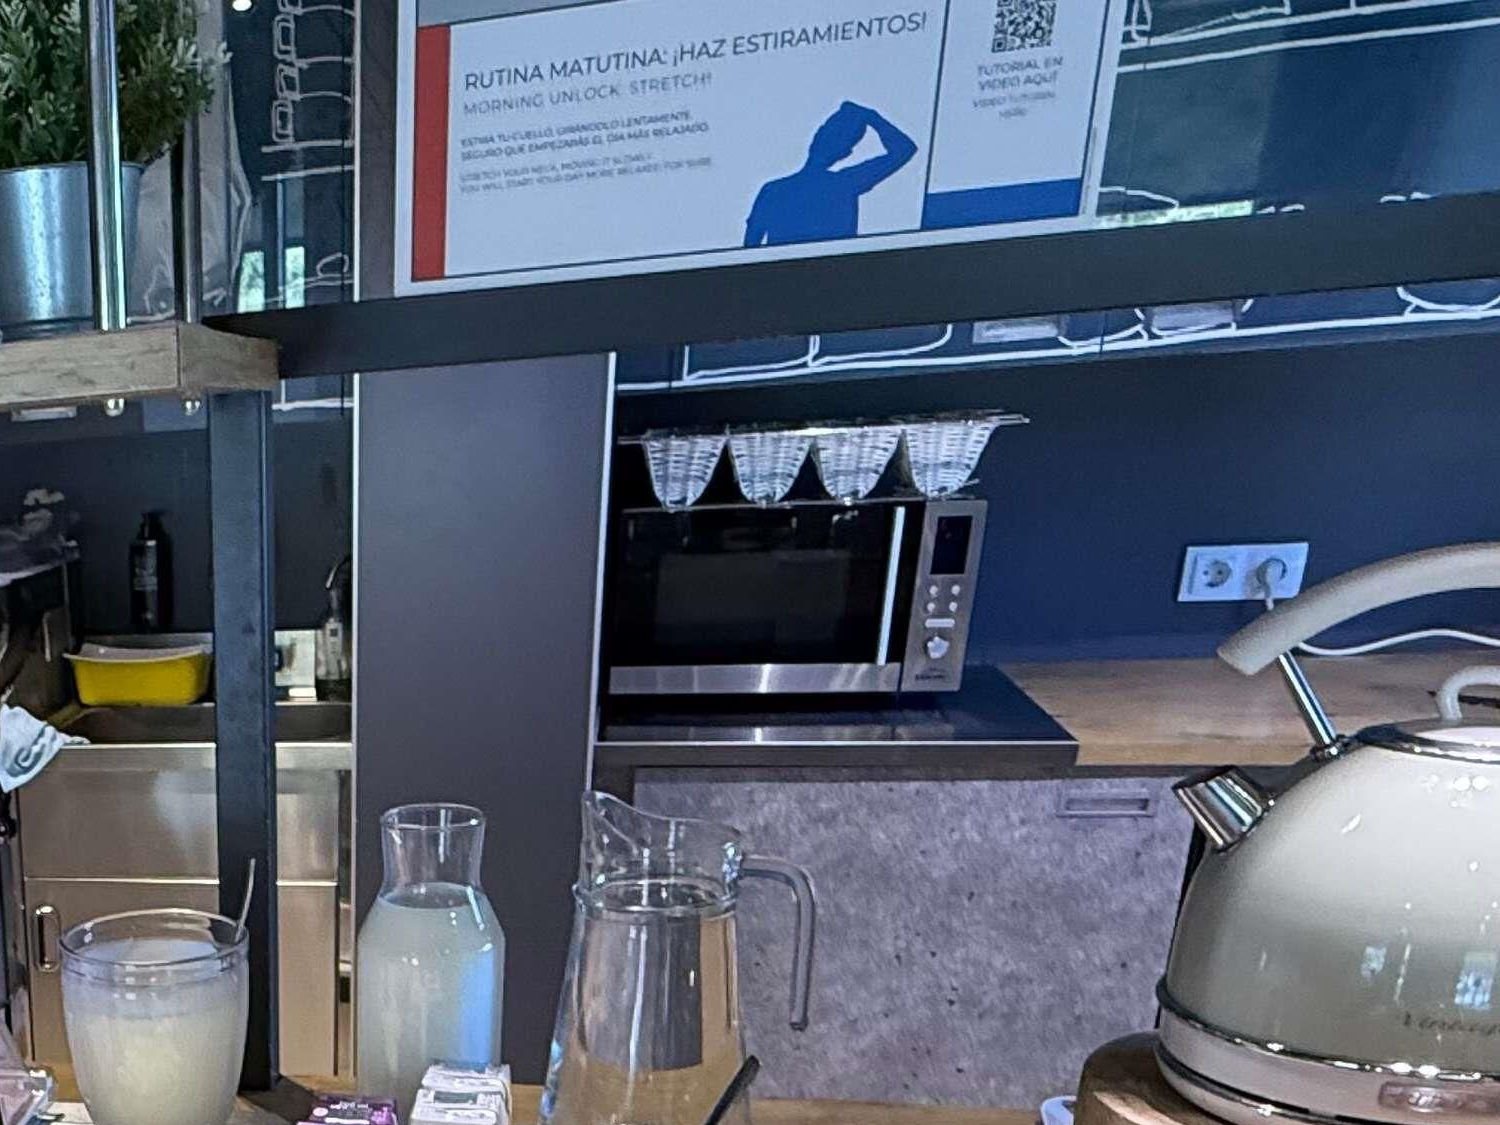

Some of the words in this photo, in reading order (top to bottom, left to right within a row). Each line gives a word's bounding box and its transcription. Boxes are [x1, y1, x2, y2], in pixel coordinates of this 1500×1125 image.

[465, 63, 544, 91] RUTINA
[462, 93, 544, 116] MORNING
[549, 84, 619, 105] UNLOCK
